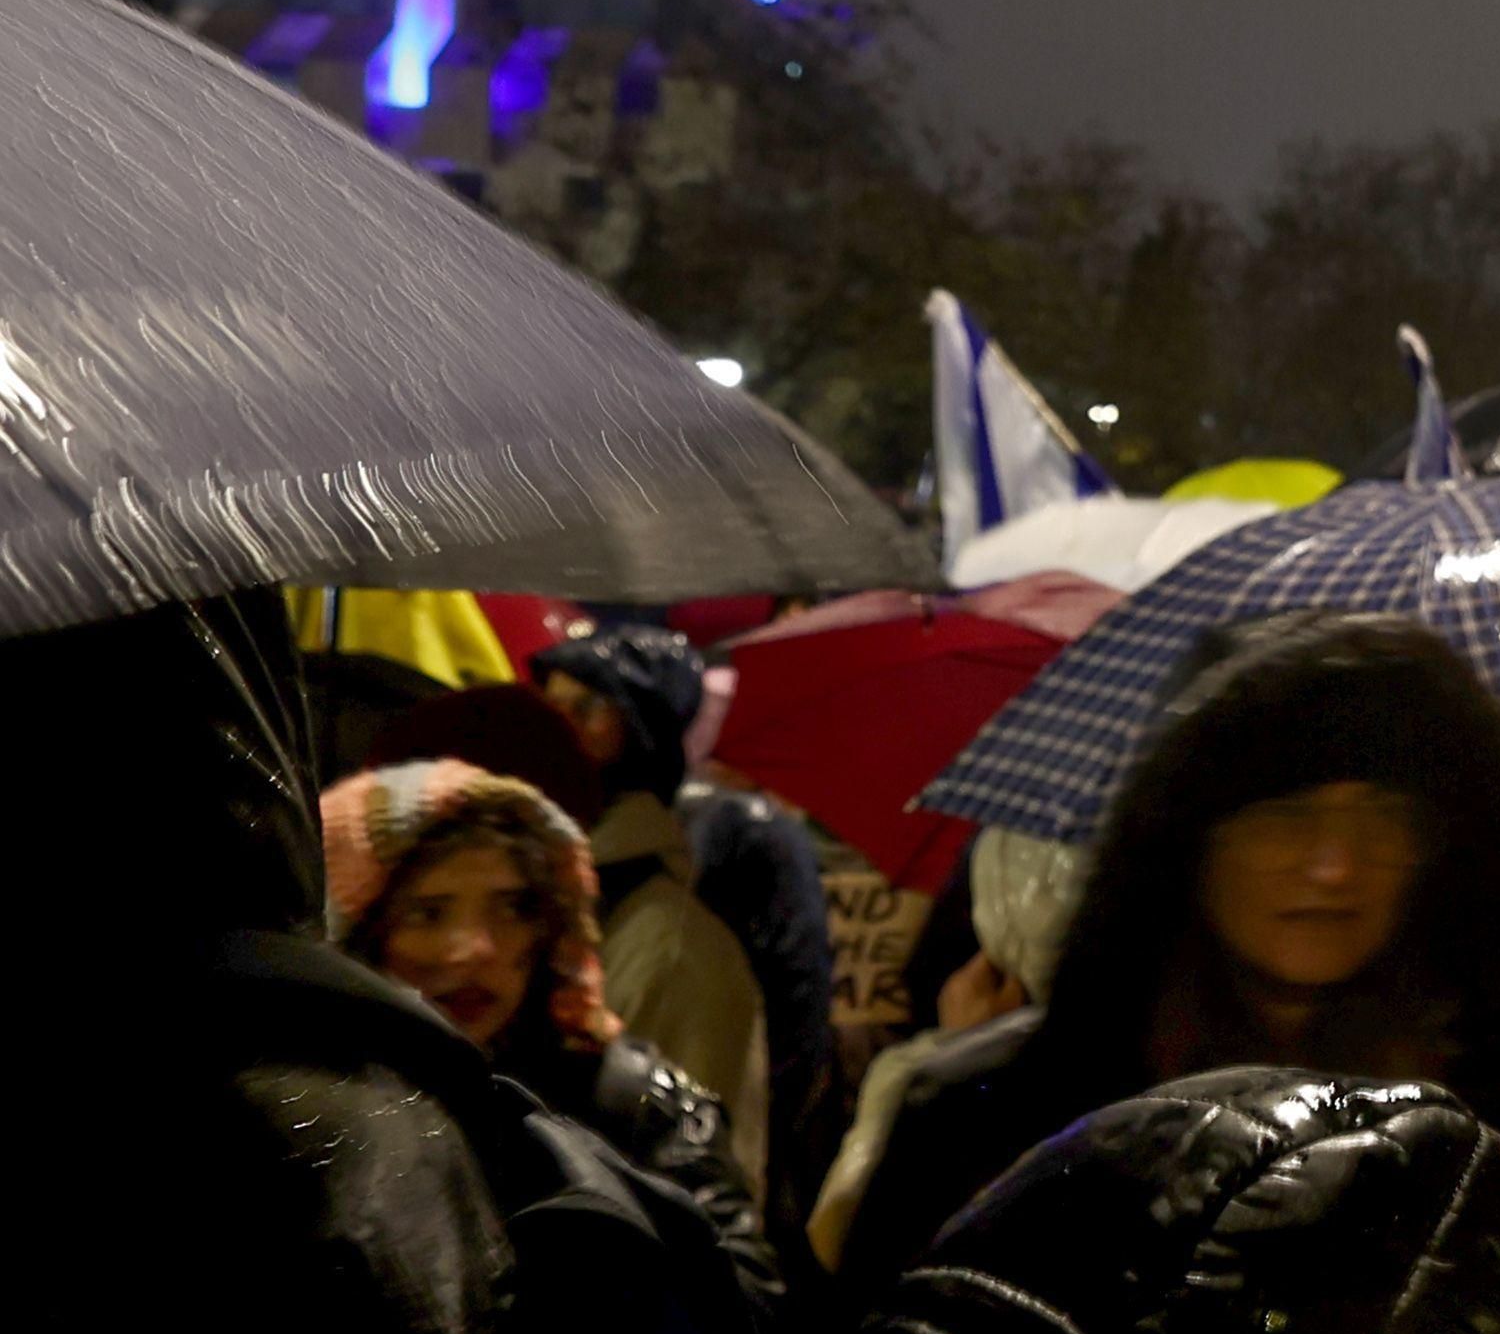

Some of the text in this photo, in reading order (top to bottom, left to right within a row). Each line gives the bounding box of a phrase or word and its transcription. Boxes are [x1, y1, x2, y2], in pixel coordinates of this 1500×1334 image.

[829, 884, 897, 923] ND
[830, 931, 908, 964] HE
[831, 969, 912, 1009] AR
